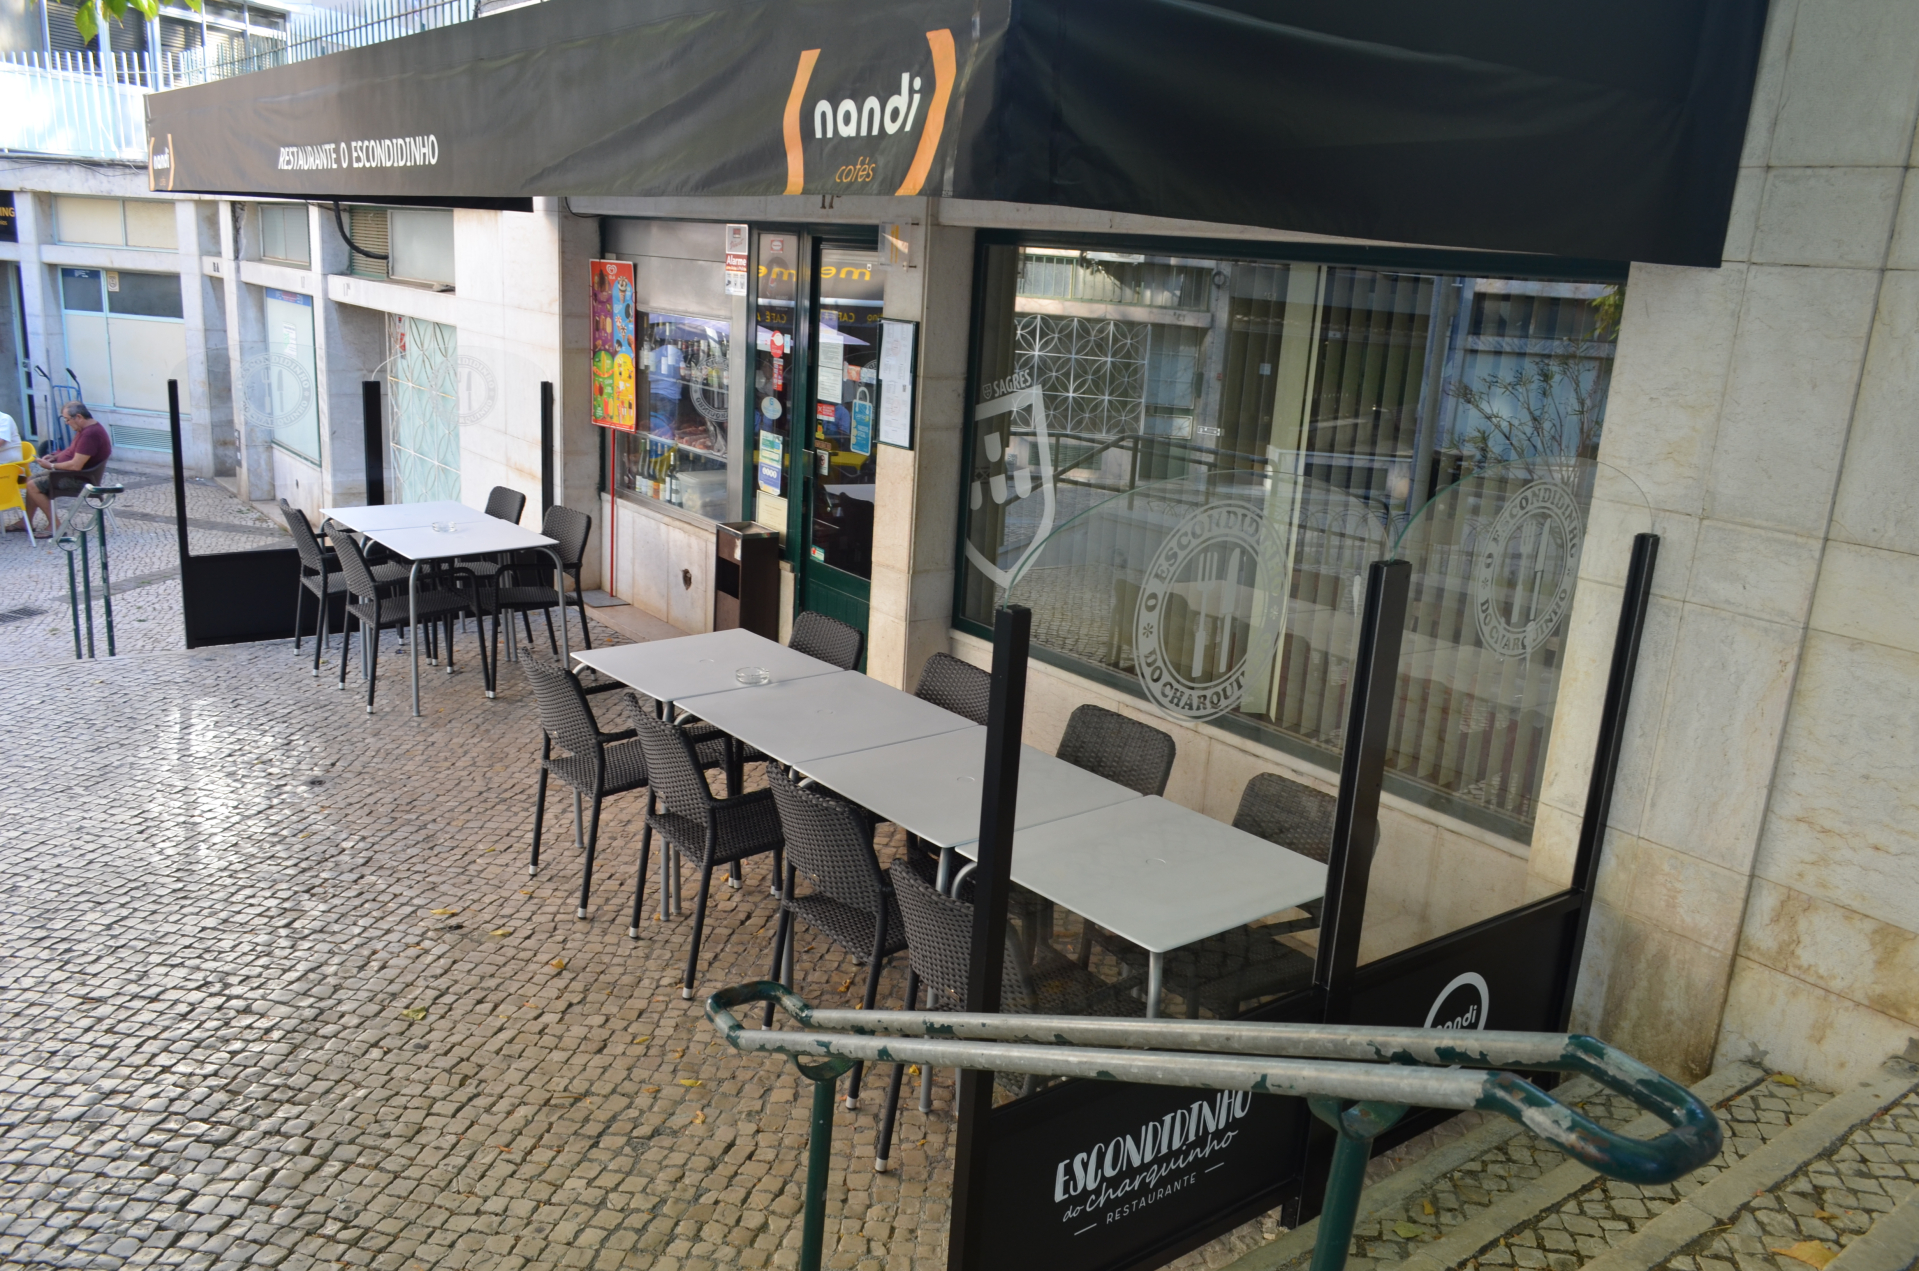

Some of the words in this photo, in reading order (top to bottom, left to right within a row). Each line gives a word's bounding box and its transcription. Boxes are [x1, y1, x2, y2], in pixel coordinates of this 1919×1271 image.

[813, 72, 921, 139] nandi
[278, 143, 338, 170] RESTAURANTE
[340, 146, 348, 169] O
[352, 134, 439, 168] ESCONDIDINHO
[726, 255, 747, 266] Alarme
[993, 369, 1032, 398] SAGRES
[1491, 487, 1579, 559] ESCONDIDINHO
[1144, 591, 1159, 613] O
[1479, 597, 1492, 627] DO
[1144, 647, 1163, 683] DO
[1054, 1090, 1252, 1203] ESCONDIDINHO
[1062, 1204, 1085, 1223] do
[1106, 1171, 1197, 1225] RESTAURANTE
